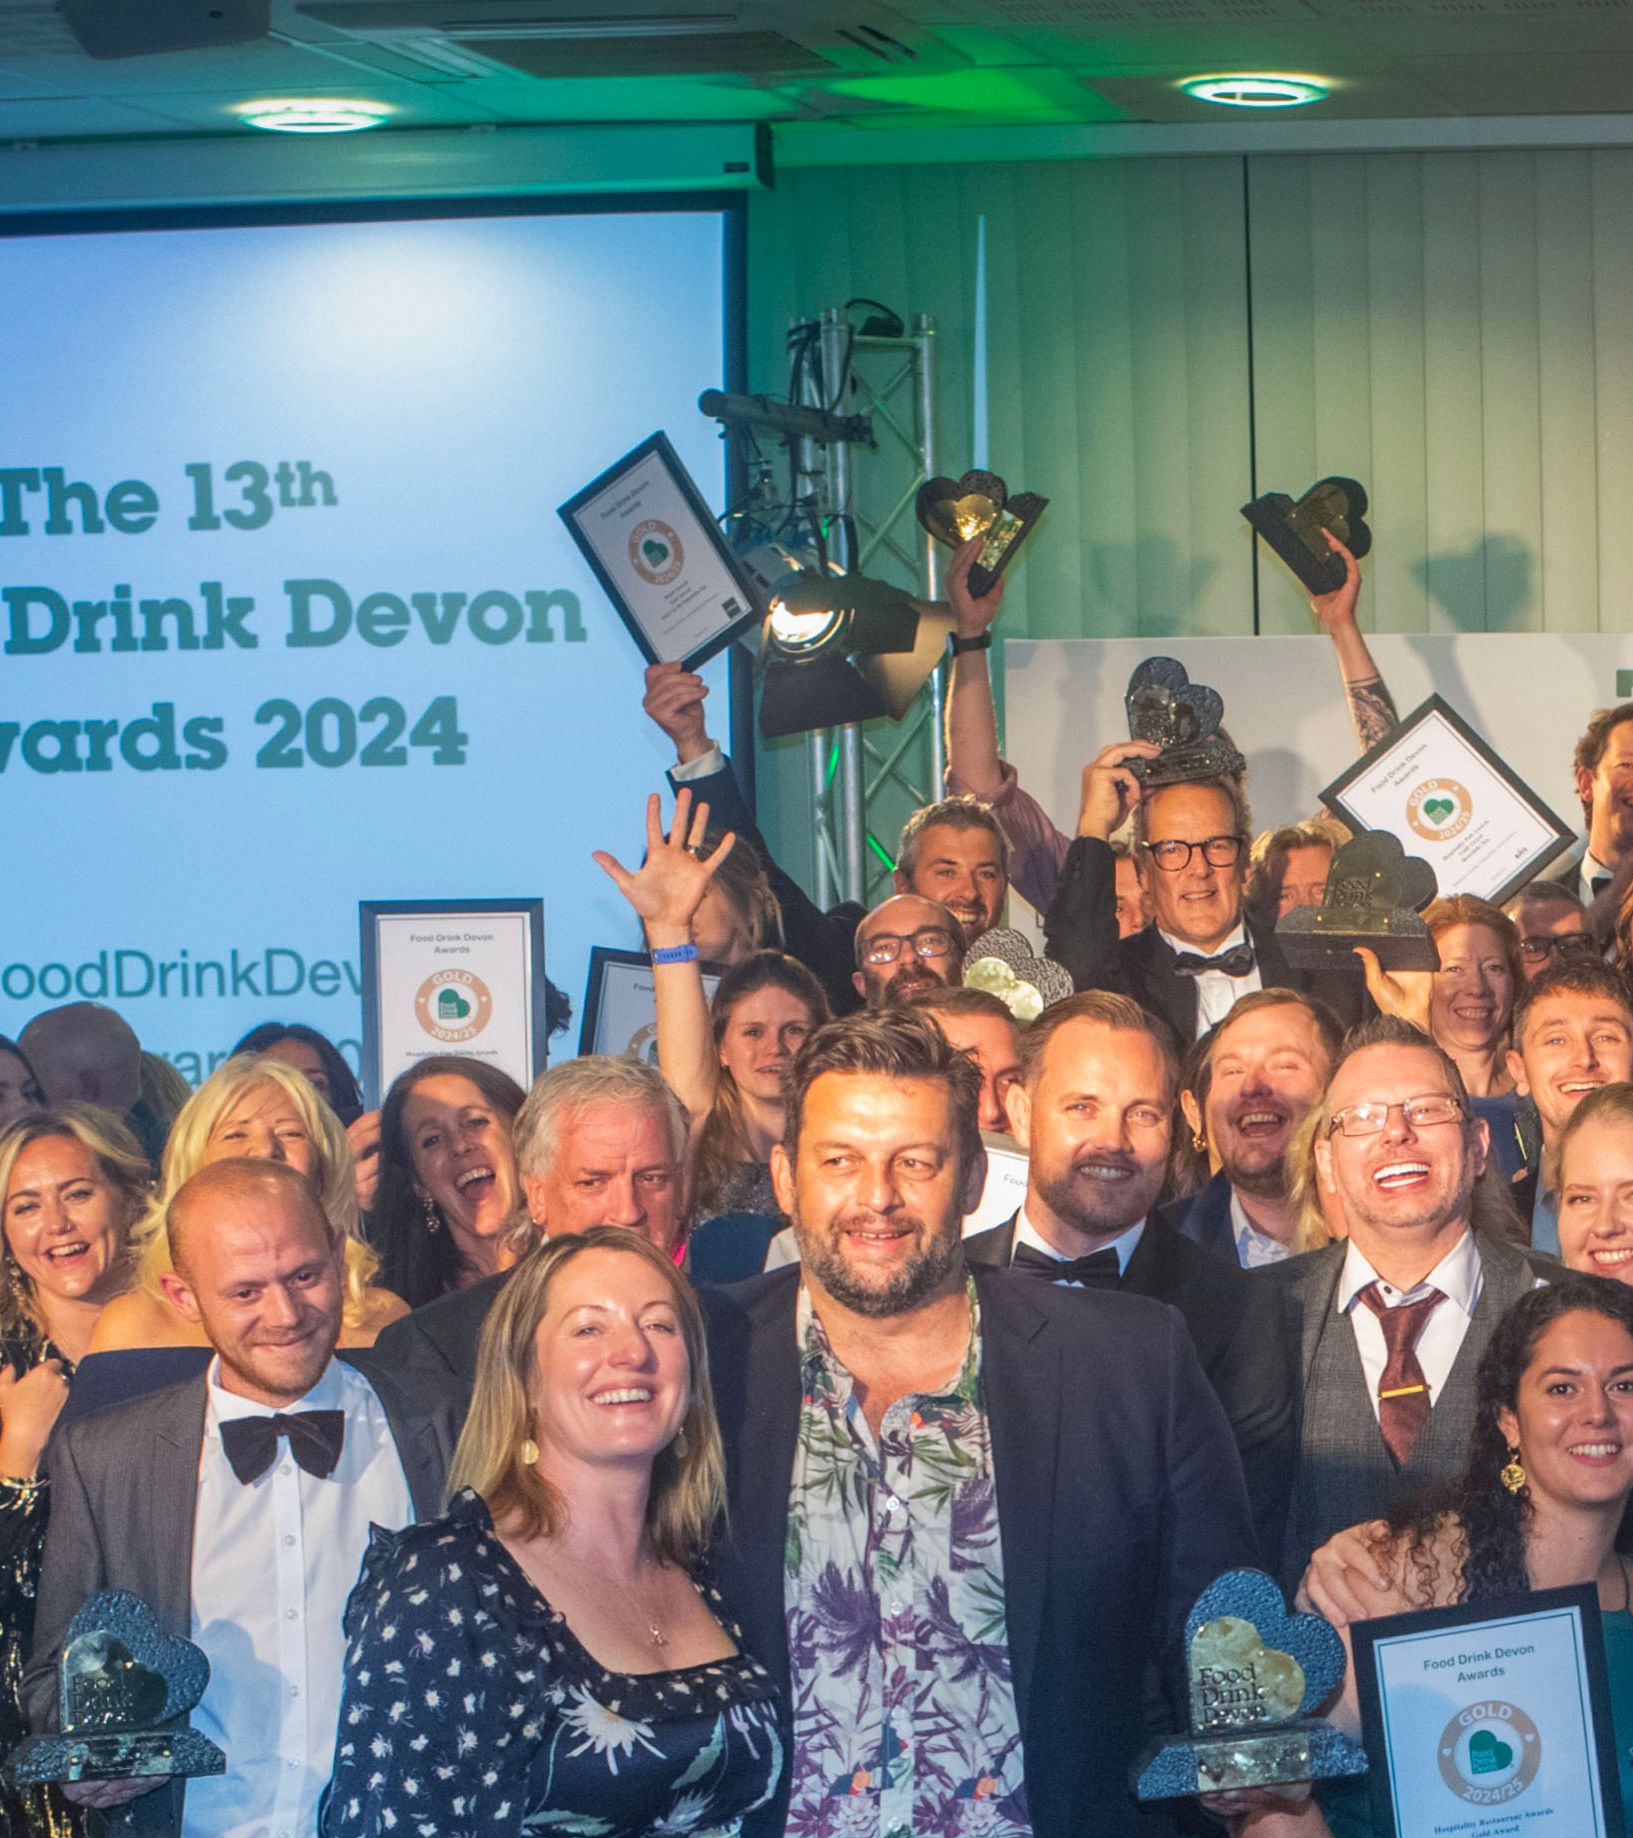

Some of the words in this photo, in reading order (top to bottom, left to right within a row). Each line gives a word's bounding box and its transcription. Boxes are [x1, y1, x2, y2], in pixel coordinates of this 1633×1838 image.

[0, 466, 159, 536] The
[185, 460, 338, 531] 13th
[1, 580, 258, 655] Drink
[283, 578, 587, 648] Devon
[255, 697, 468, 769] 2024
[1423, 1655, 1454, 1671] Food
[1457, 1648, 1492, 1666] Drink
[1494, 1641, 1534, 1659] Devon
[1199, 1662, 1257, 1686] Food
[1456, 1665, 1505, 1684] Awards
[1201, 1684, 1266, 1706] Drink
[1203, 1706, 1267, 1724] Devon
[1459, 1703, 1513, 1726] GOLD
[1462, 1778, 1523, 1801] 2024/25
